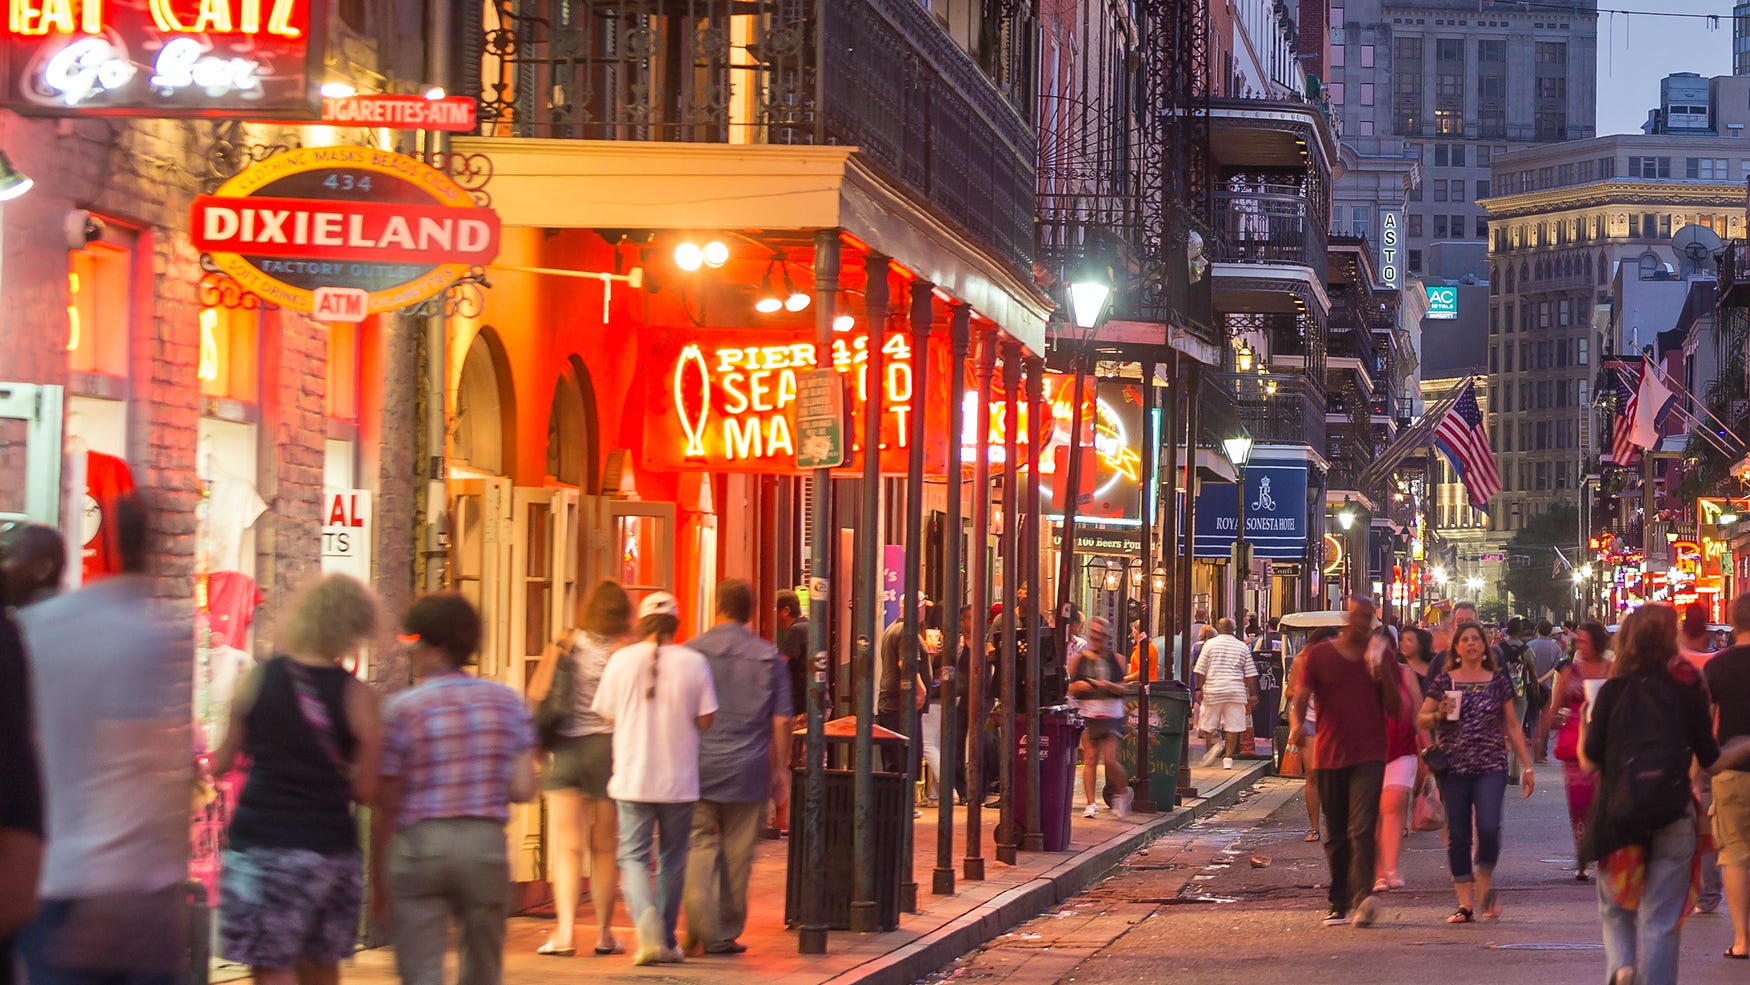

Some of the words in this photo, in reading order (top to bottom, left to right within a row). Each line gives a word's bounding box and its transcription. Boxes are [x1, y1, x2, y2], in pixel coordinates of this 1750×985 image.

[314, 150, 366, 164] MASKS
[372, 153, 417, 177] BEADS
[323, 174, 373, 193] 434
[203, 207, 491, 252] DIXIELAND
[1383, 213, 1396, 289] ASTO
[261, 260, 343, 275] FACTORY
[351, 263, 419, 279] OUTLET
[319, 292, 362, 315] ATM
[1429, 290, 1453, 303] AC
[716, 343, 817, 372] PIER
[723, 363, 912, 414] SEAD
[723, 406, 912, 460] MAT
[1216, 517, 1245, 530] ROYA
[1246, 518, 1278, 530] SONESTA
[1280, 518, 1295, 530] HOTEL
[1078, 538, 1094, 546] 100
[1096, 538, 1121, 548] Beers
